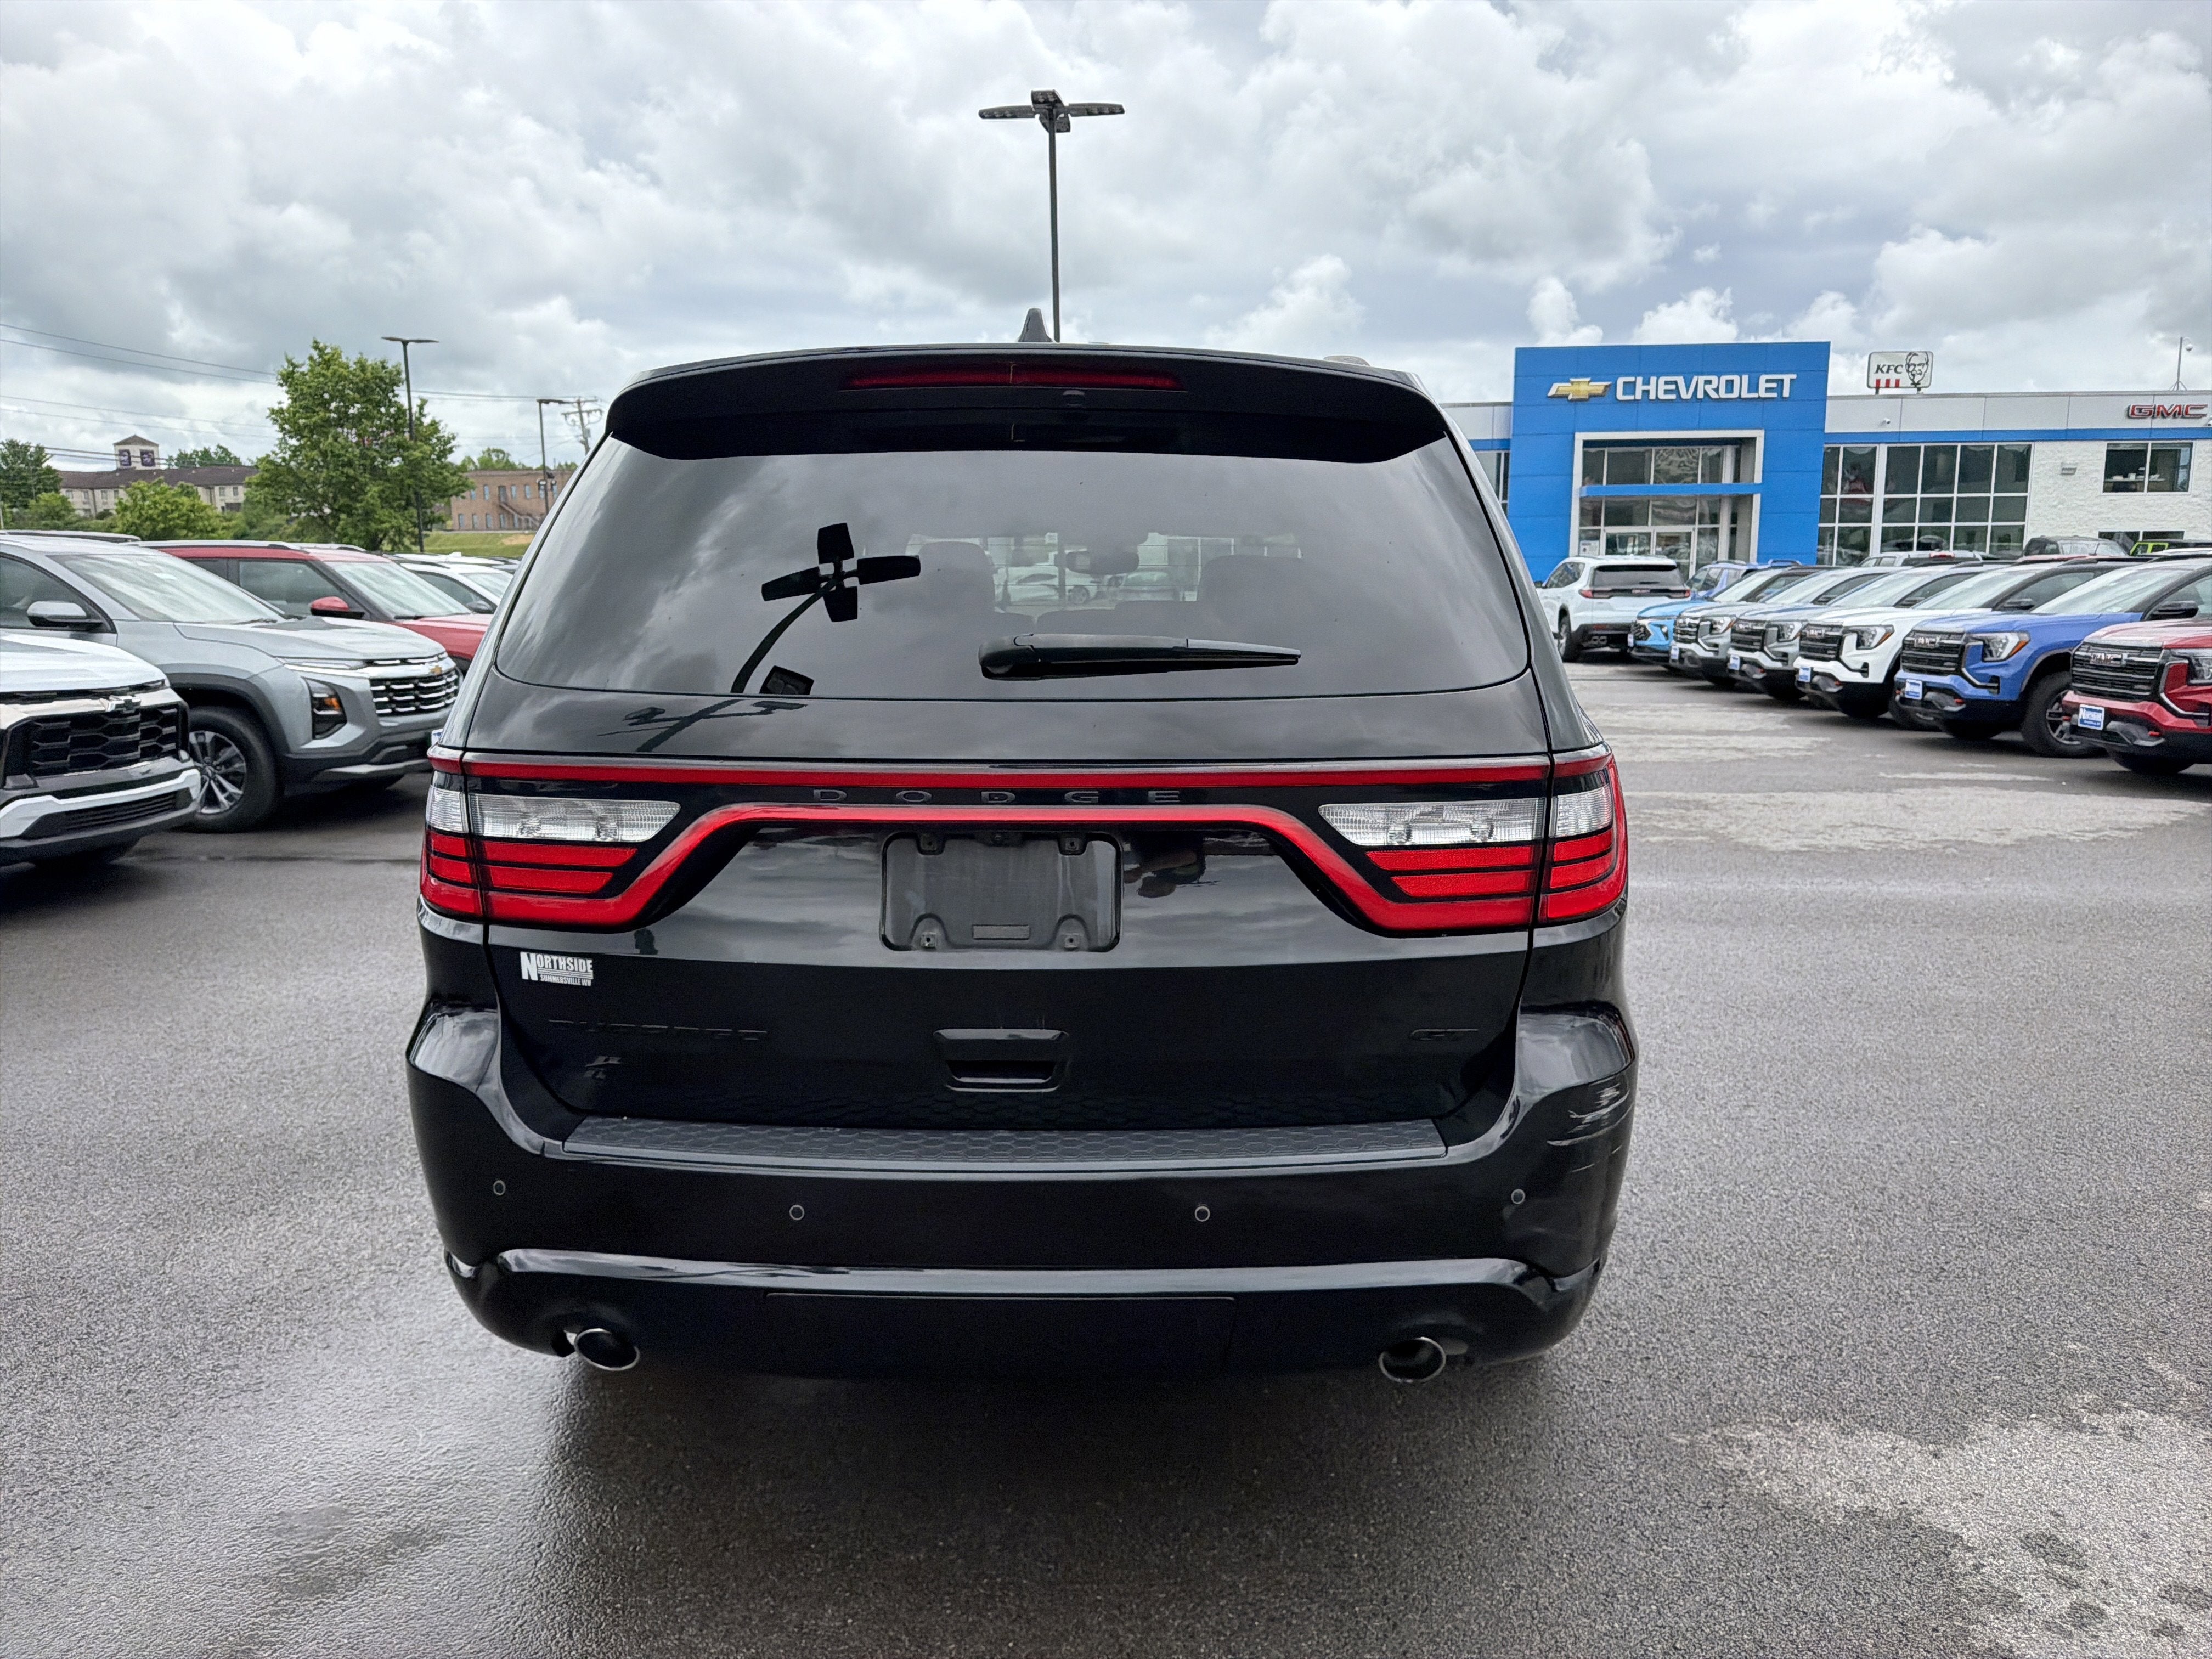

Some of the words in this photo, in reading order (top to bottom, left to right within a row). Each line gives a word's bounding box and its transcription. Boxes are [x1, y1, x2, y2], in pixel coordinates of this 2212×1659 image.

[1874, 364, 1904, 374] KFC
[1616, 374, 1797, 400] CHEVROLET
[2127, 404, 2208, 419] GMC
[813, 788, 1181, 804] DODGE
[520, 951, 594, 981] NORTHSIDE
[540, 974, 580, 986] SUMMERSVILLE
